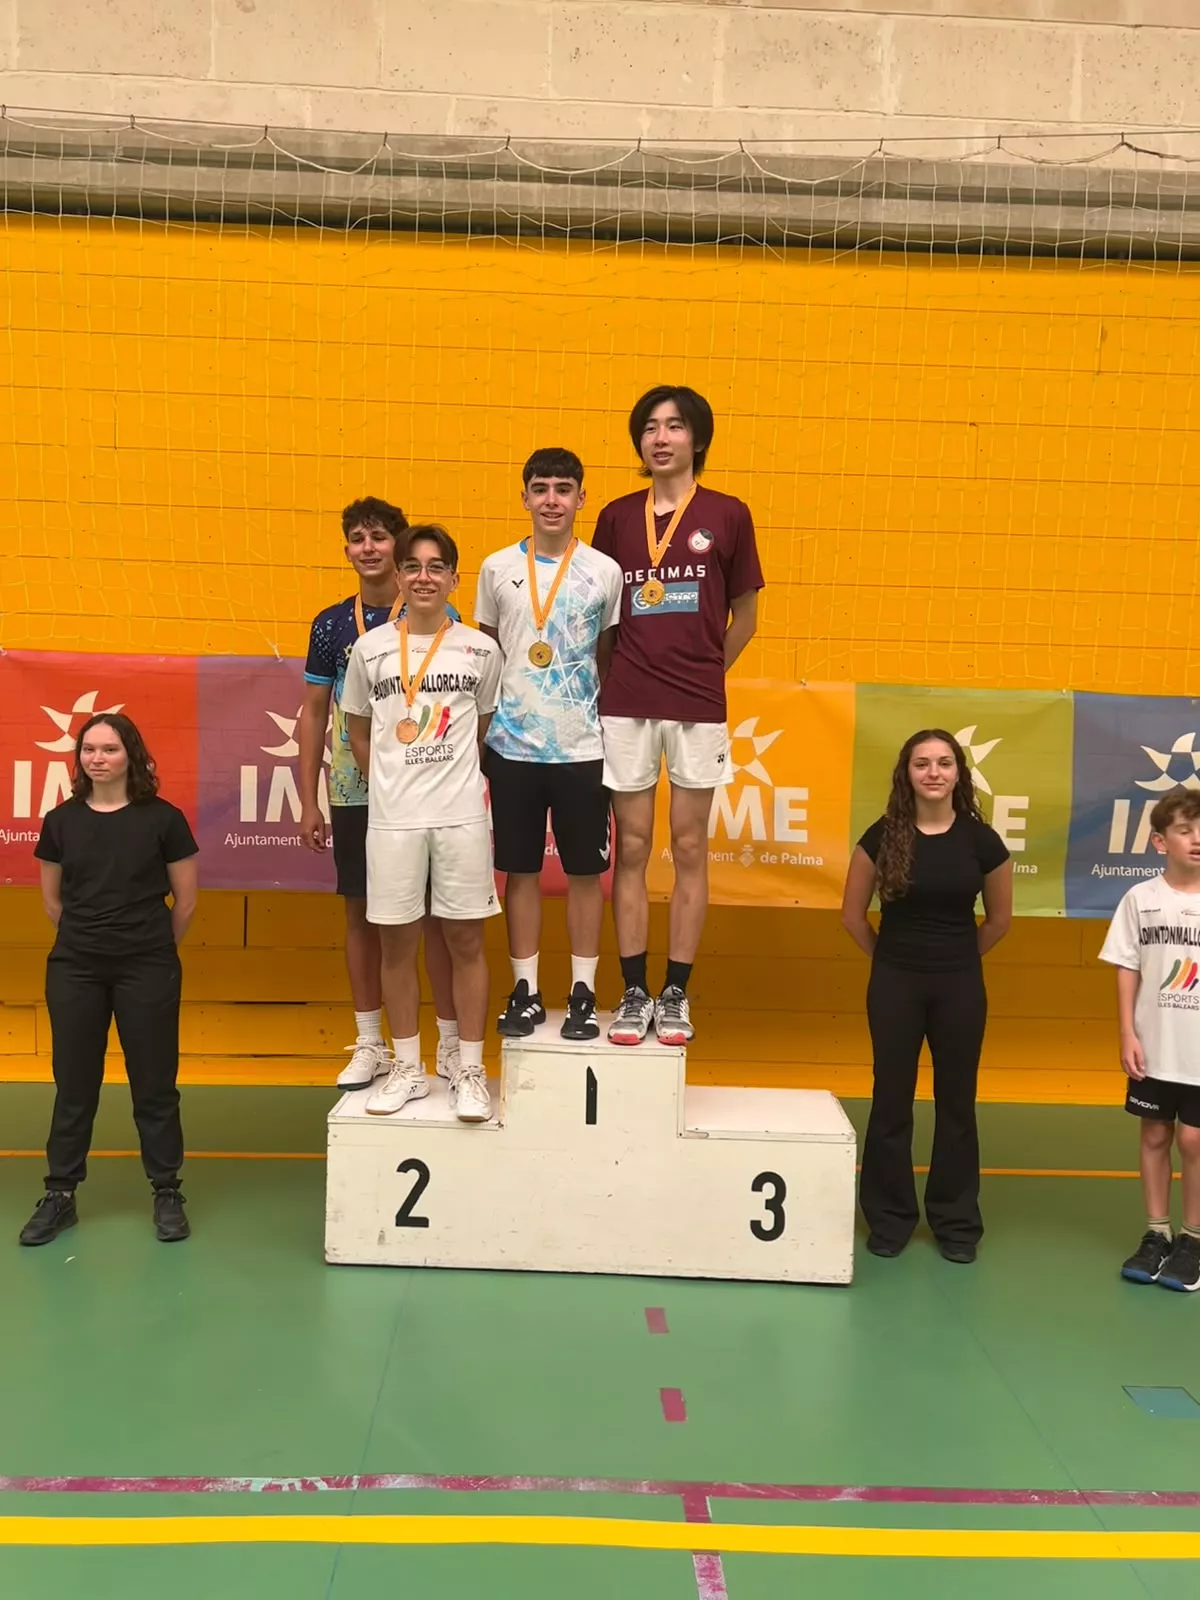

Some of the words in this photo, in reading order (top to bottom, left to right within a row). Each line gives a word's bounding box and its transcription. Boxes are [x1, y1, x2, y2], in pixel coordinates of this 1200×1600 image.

[624, 564, 706, 584] DECIMAS
[405, 743, 454, 758] ESPORTS
[239, 765, 332, 823] IM
[708, 785, 809, 843] ME
[0, 828, 40, 845] Ajunta
[224, 833, 301, 848] Ajuntament
[760, 852, 778, 864] de
[781, 852, 824, 866] Palma
[1013, 862, 1038, 875] lma
[1091, 863, 1165, 879] Ajuntament
[585, 1066, 598, 1125] 1
[395, 1158, 430, 1228] 2
[750, 1171, 786, 1241] 3
